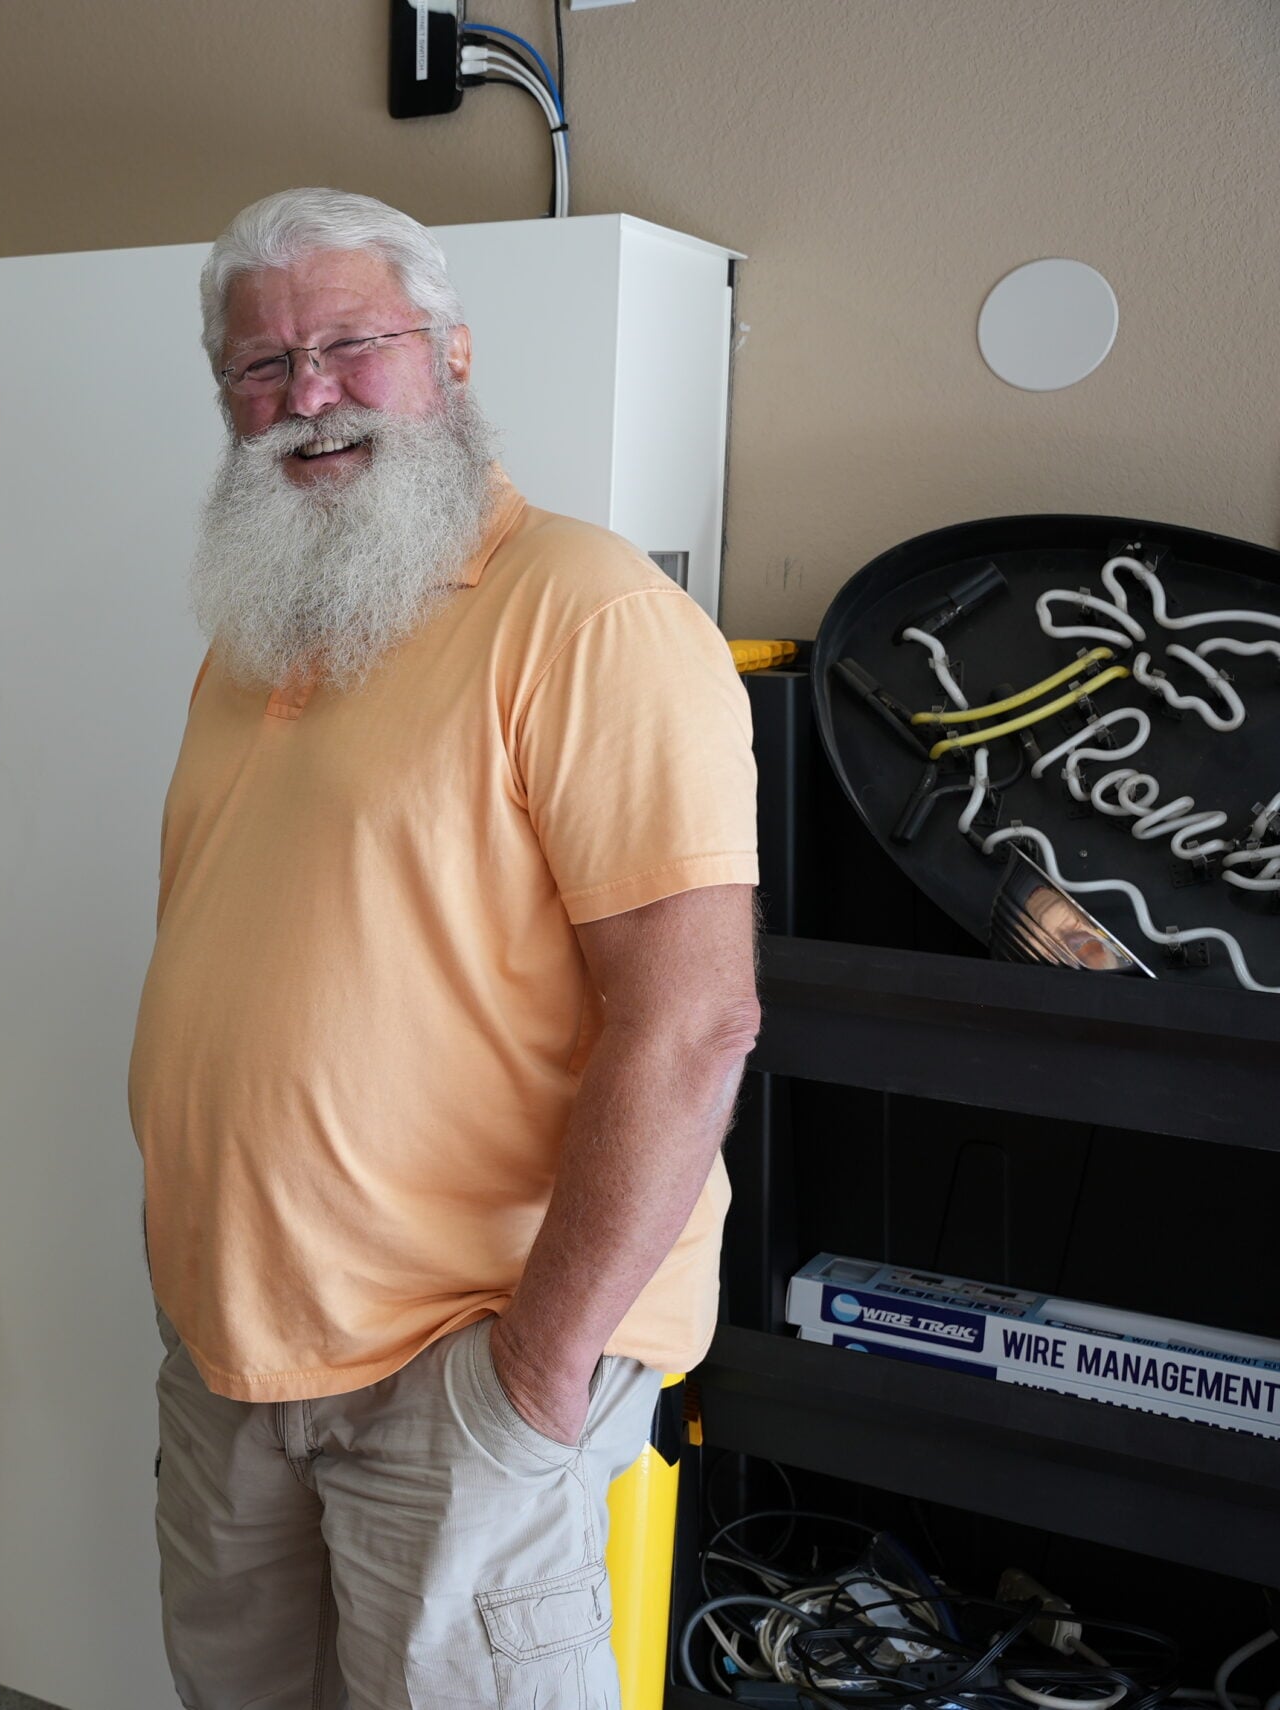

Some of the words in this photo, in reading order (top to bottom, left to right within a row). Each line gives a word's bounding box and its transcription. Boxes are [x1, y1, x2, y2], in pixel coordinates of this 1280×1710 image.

[418, 39, 426, 71] SWITCH
[862, 1306, 913, 1326] WIRE
[916, 1317, 974, 1338] TRAK
[1132, 1336, 1162, 1348] WIRE
[1166, 1343, 1259, 1367] MANAGEMENT
[1002, 1328, 1067, 1369] WIRE
[1076, 1344, 1280, 1413] MANAGEMENT
